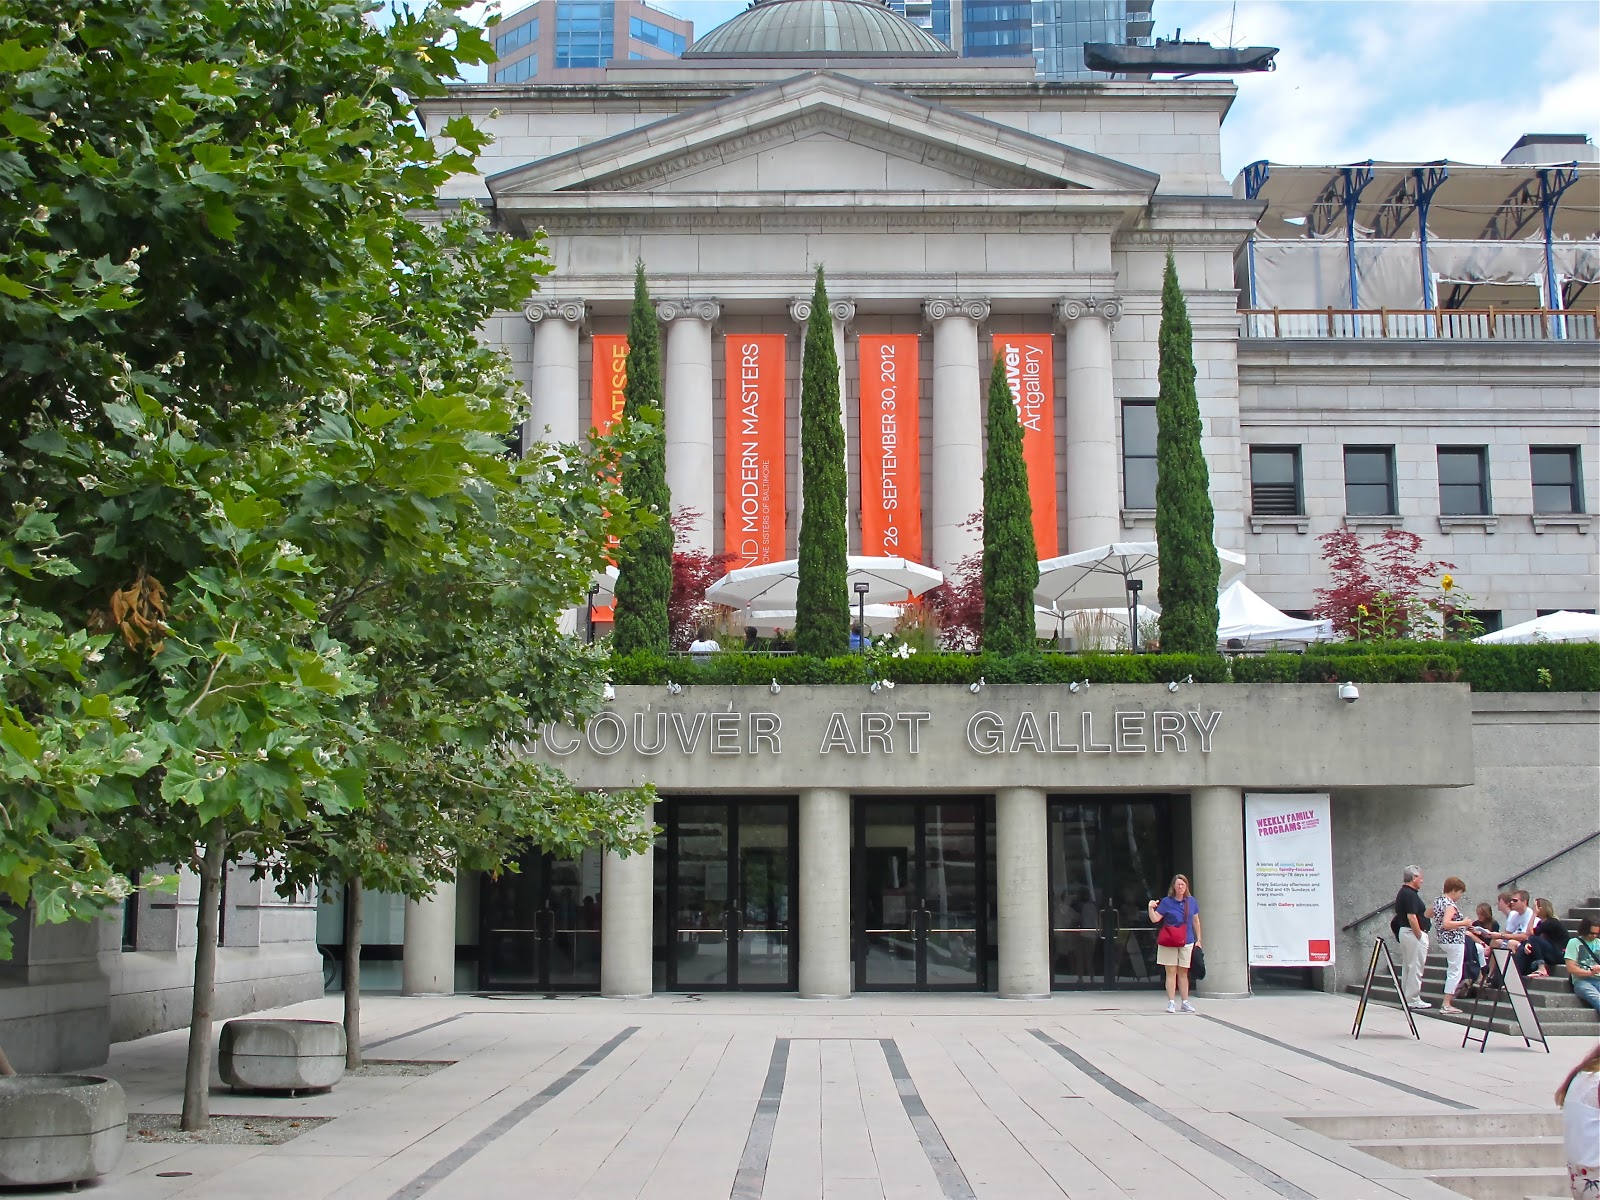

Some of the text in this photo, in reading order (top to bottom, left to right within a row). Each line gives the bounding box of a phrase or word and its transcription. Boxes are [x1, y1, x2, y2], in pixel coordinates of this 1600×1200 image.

[611, 344, 629, 422] ATISSE
[880, 344, 896, 383] 2012
[881, 385, 898, 411] 30,
[1022, 344, 1045, 432] Artgallery
[741, 343, 759, 569] ND MODERN MASTERS
[881, 414, 898, 510] SEPTEMBER
[762, 459, 770, 565] ONE SISTERS OF BALTIMORE
[883, 526, 899, 547] 26
[819, 711, 931, 755] ART
[966, 710, 1223, 755] GALLERY
[1256, 815, 1286, 828] WEEKLY
[1286, 810, 1314, 823] FAMILY
[1258, 821, 1302, 837] PROGRAMS
